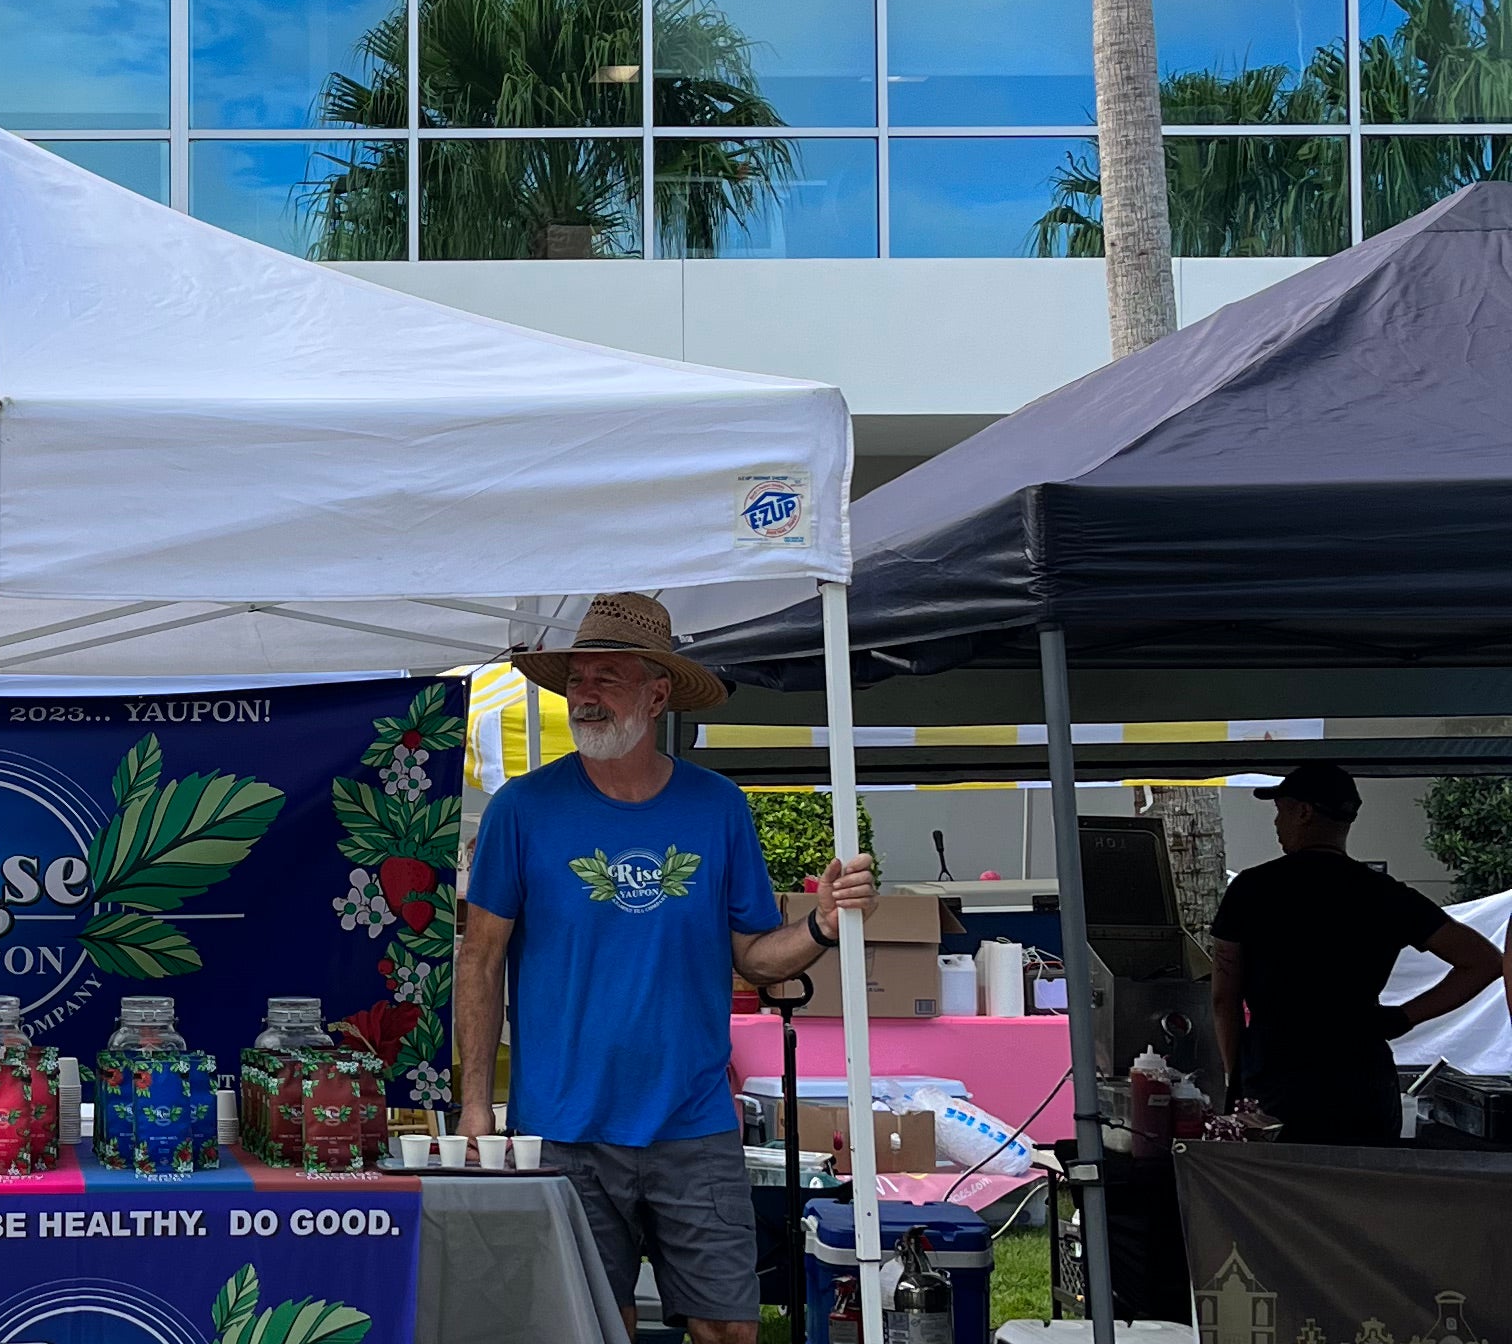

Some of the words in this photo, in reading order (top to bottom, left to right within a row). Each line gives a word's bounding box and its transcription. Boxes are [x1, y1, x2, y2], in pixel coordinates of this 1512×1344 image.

[124, 699, 271, 723] YAUPON!
[608, 863, 663, 890] Rise
[619, 888, 659, 899] YAUPON
[20, 972, 103, 1040] OMPANY
[39, 1209, 207, 1238] HEALTHY.
[229, 1209, 279, 1237] DO
[289, 1208, 400, 1236] GOOD.
